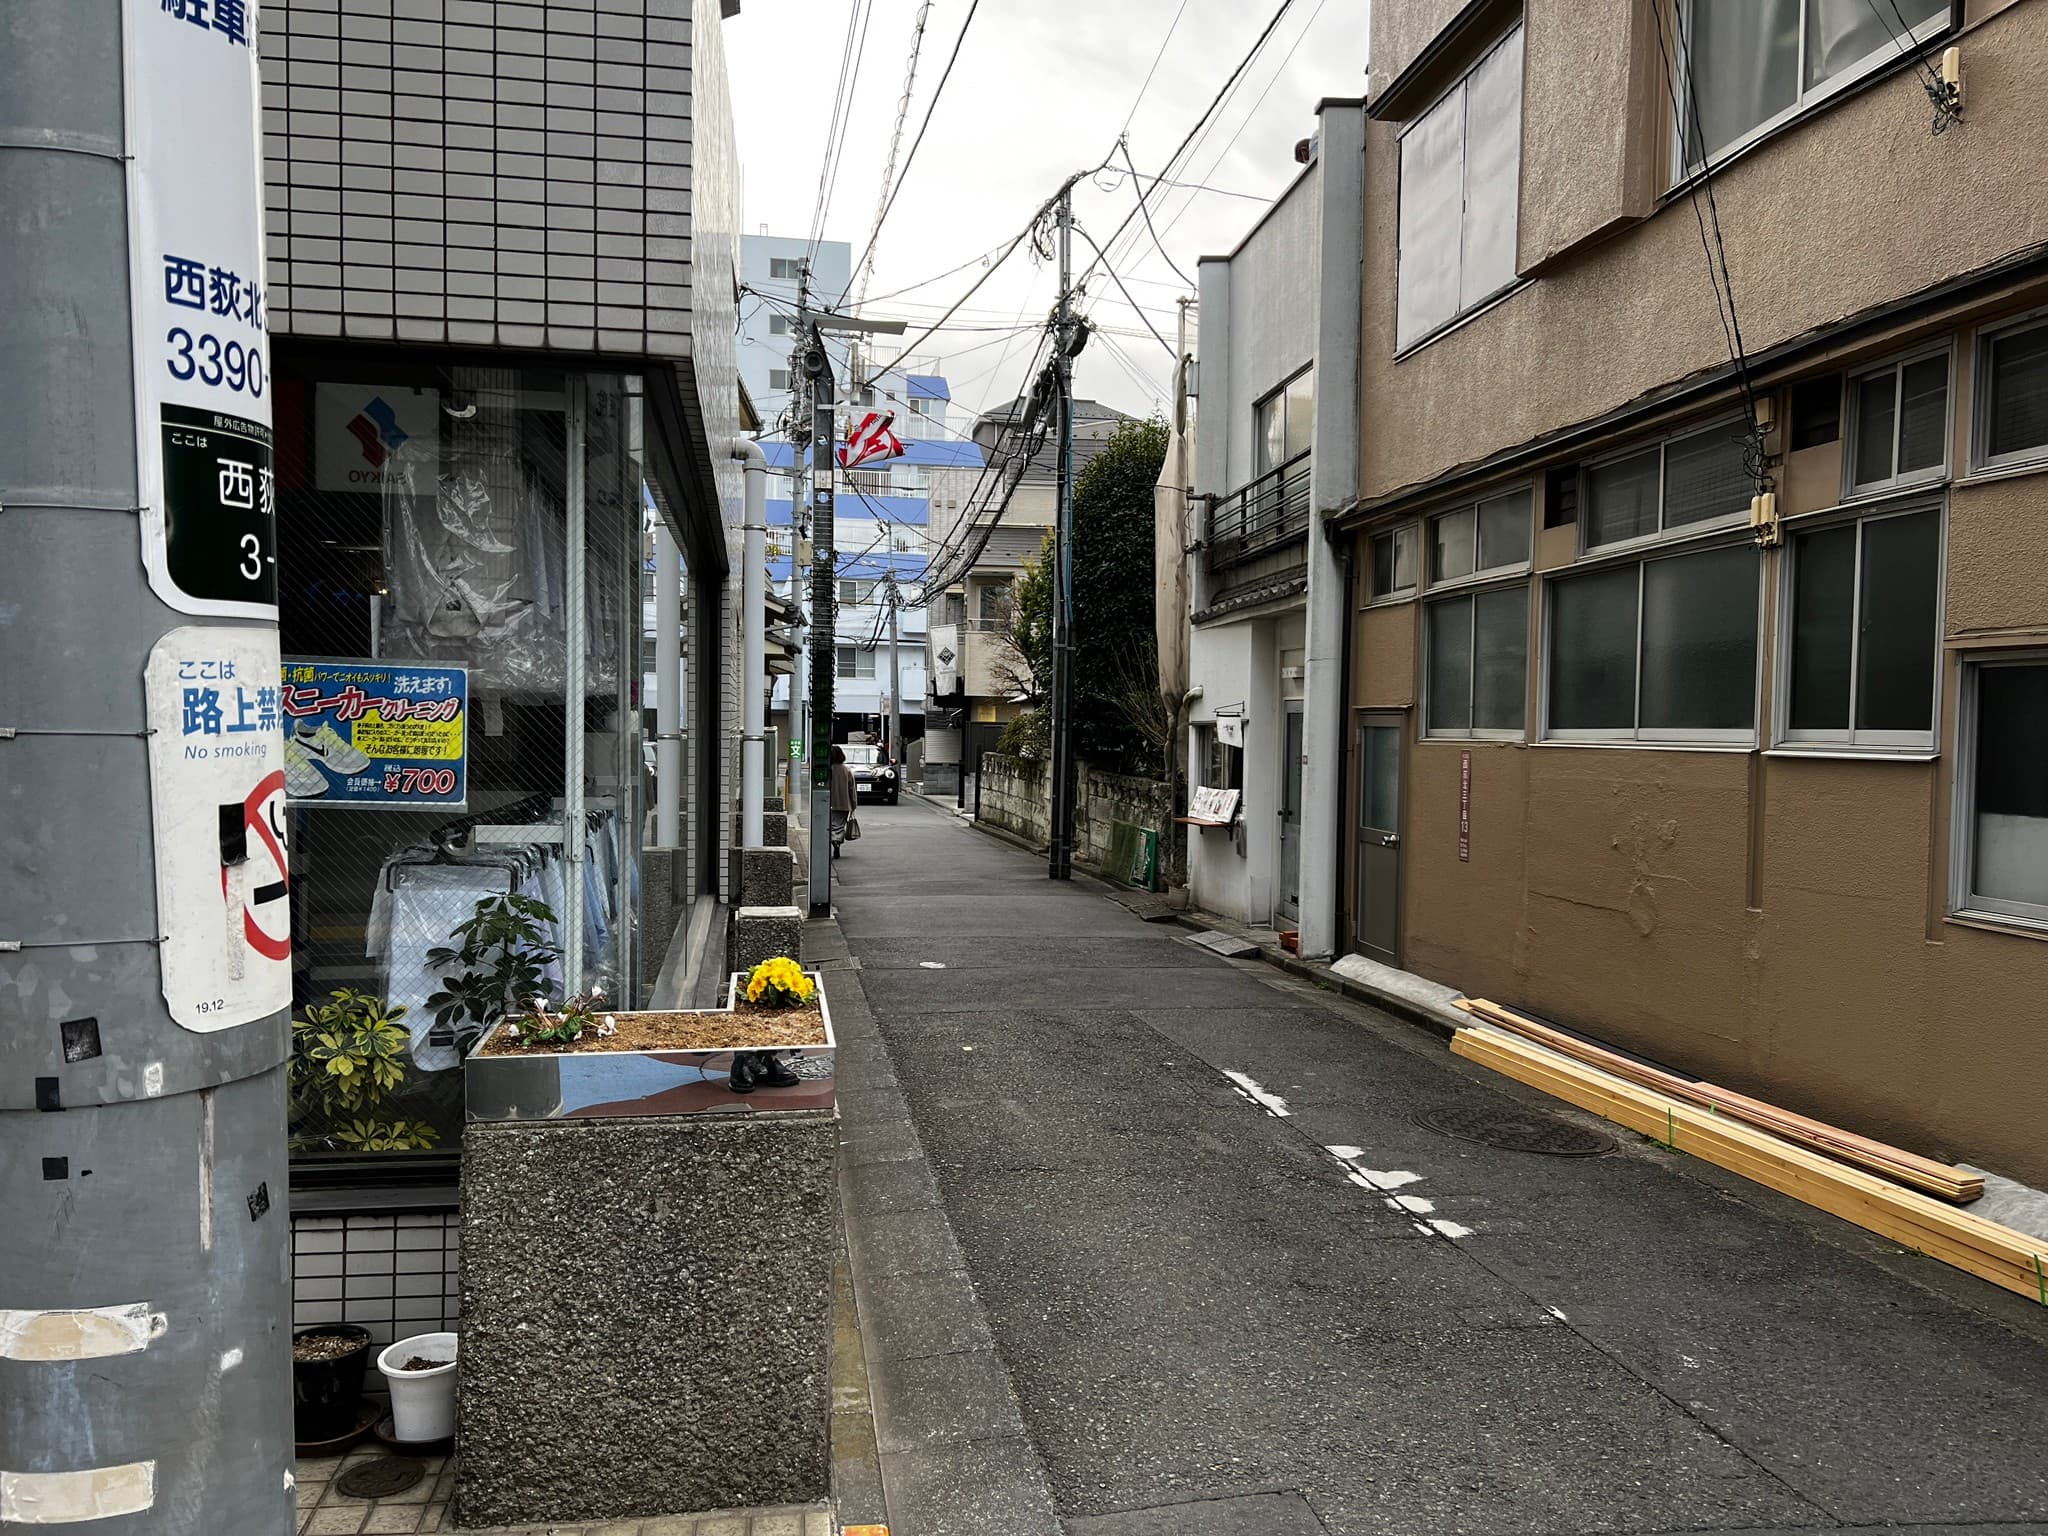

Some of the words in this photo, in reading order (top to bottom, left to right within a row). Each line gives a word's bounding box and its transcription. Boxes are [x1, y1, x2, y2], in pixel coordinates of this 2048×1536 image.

[171, 433, 208, 448] ここは
[178, 661, 235, 679] ここは
[184, 745, 208, 759] No
[214, 742, 267, 758] smoking
[384, 768, 455, 793] ¥700
[195, 999, 224, 1014] 19.12
